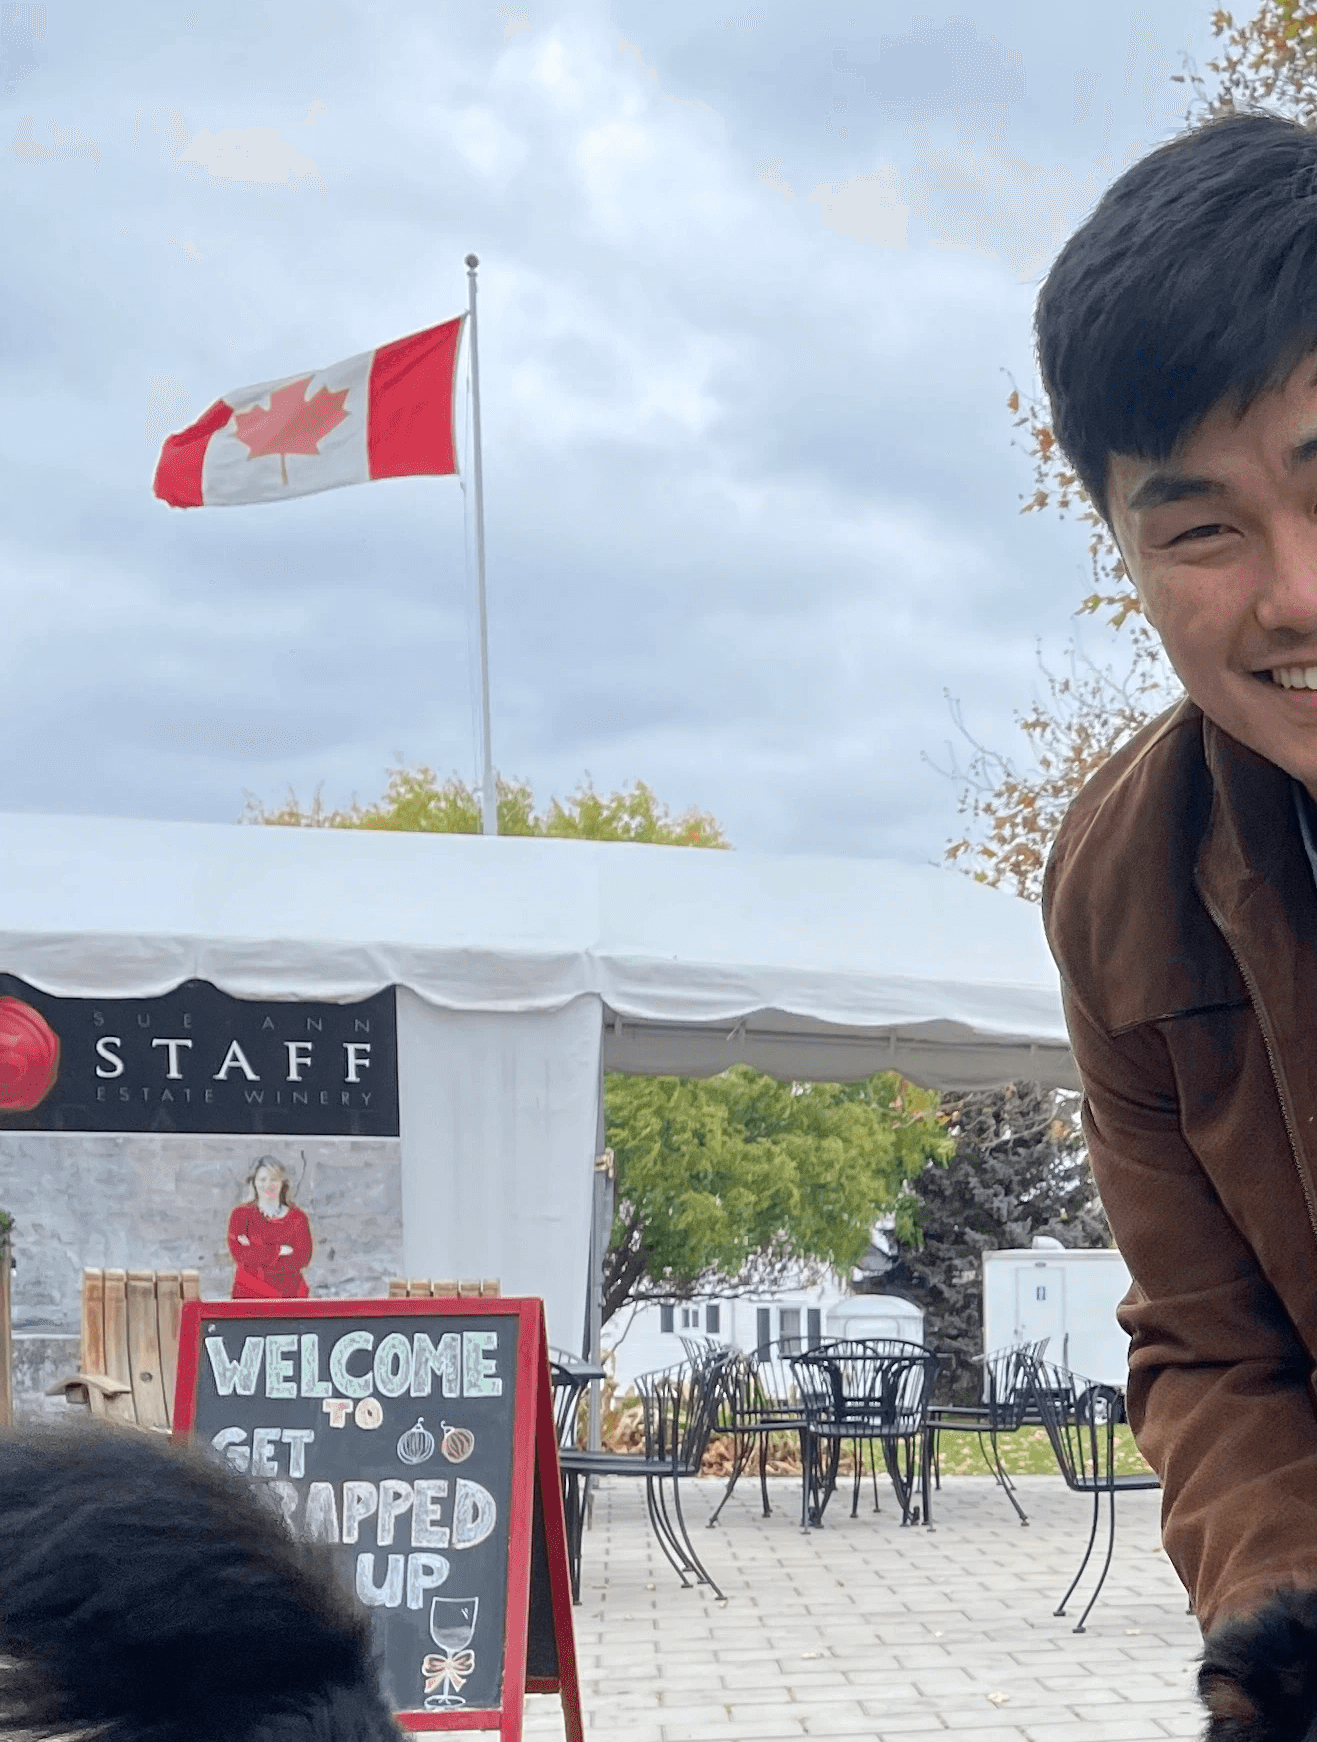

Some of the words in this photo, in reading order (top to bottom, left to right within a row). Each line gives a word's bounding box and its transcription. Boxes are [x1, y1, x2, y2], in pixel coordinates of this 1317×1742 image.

[95, 1036, 371, 1083] STAFF
[96, 1087, 214, 1103] ESTATE
[244, 1089, 372, 1105] WINERY
[205, 1331, 502, 1398] WELCOME
[322, 1397, 383, 1430] TO
[211, 1426, 315, 1478] GET
[250, 1477, 497, 1549] RAPPED
[356, 1552, 450, 1610] UP
